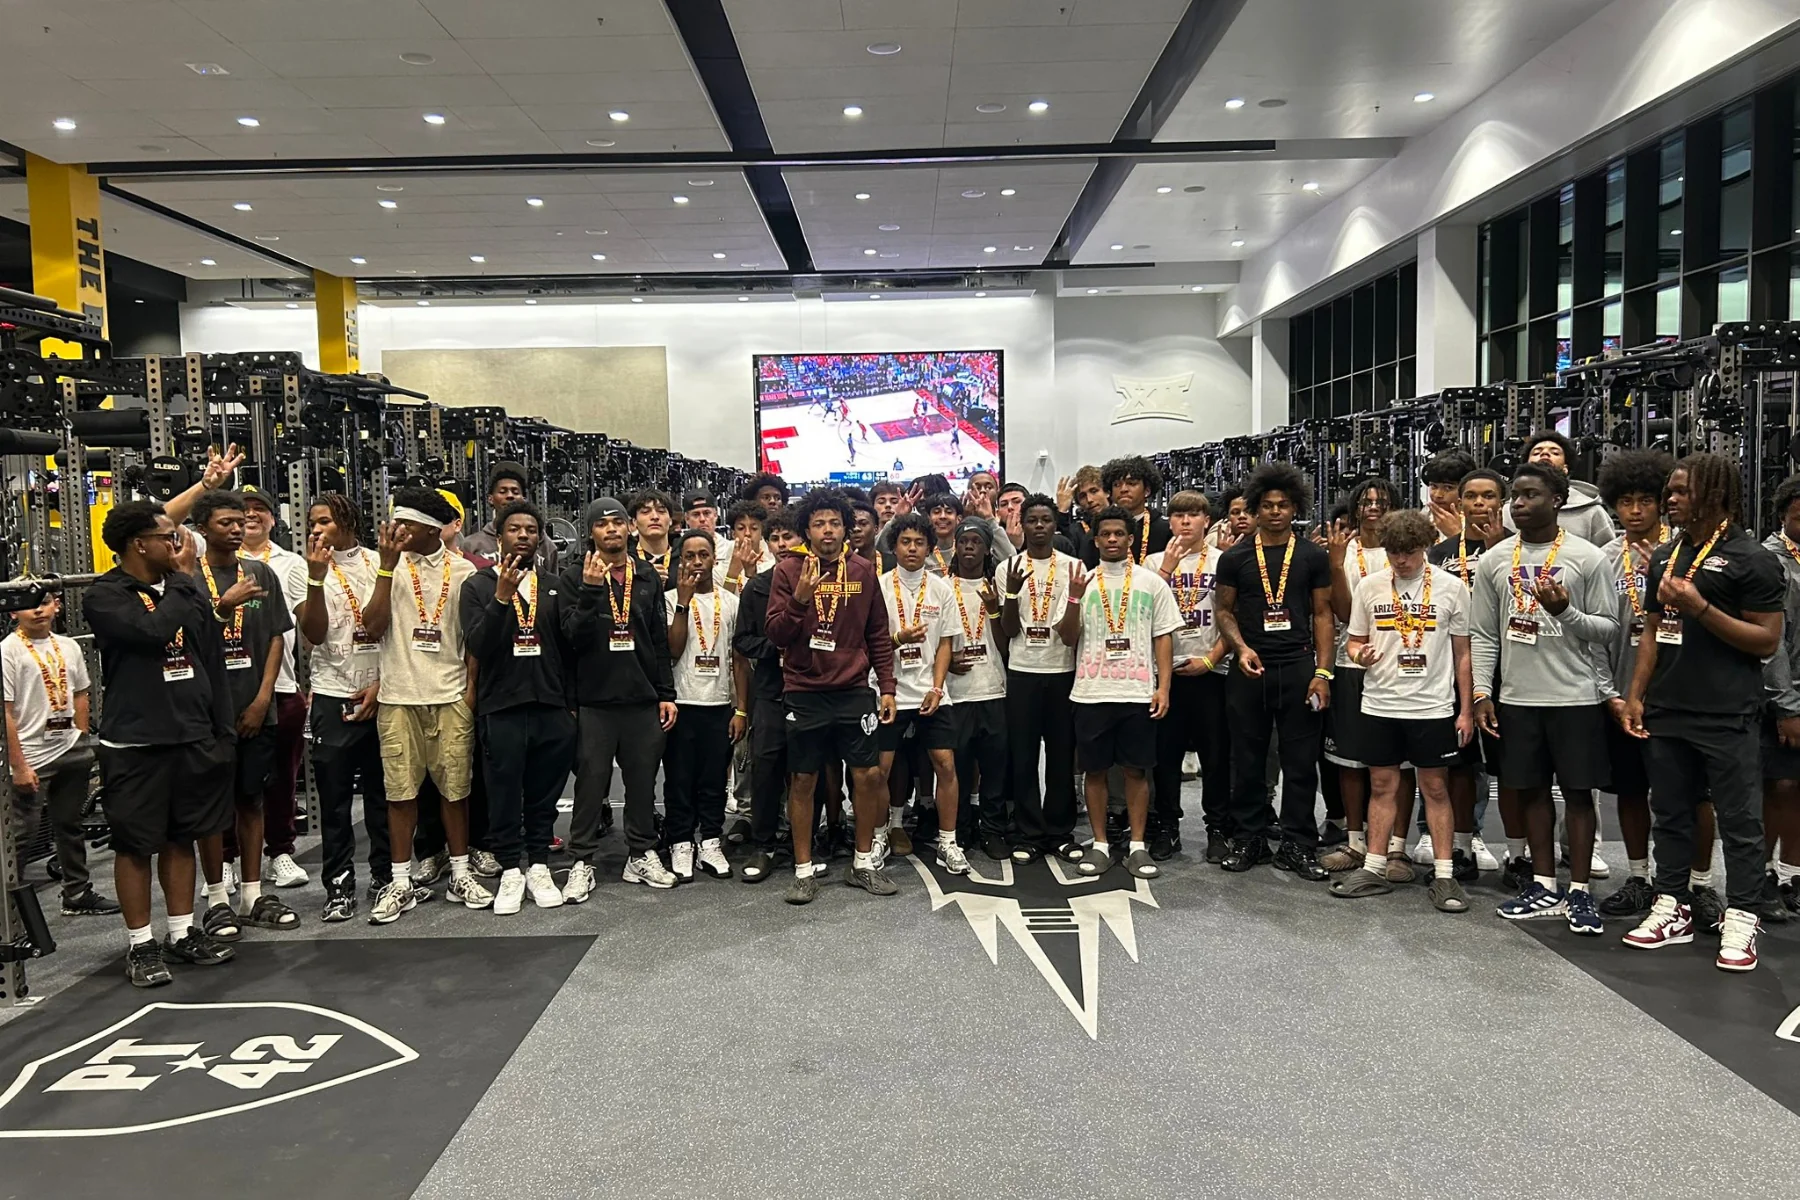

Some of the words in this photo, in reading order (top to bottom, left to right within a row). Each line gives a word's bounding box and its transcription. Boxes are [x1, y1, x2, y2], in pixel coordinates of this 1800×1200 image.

[76, 217, 102, 293] THE
[153, 462, 181, 471] ELEIKO
[1166, 573, 1217, 589] HAVEZ
[42, 1038, 205, 1093] PT
[206, 1034, 344, 1090] 42
